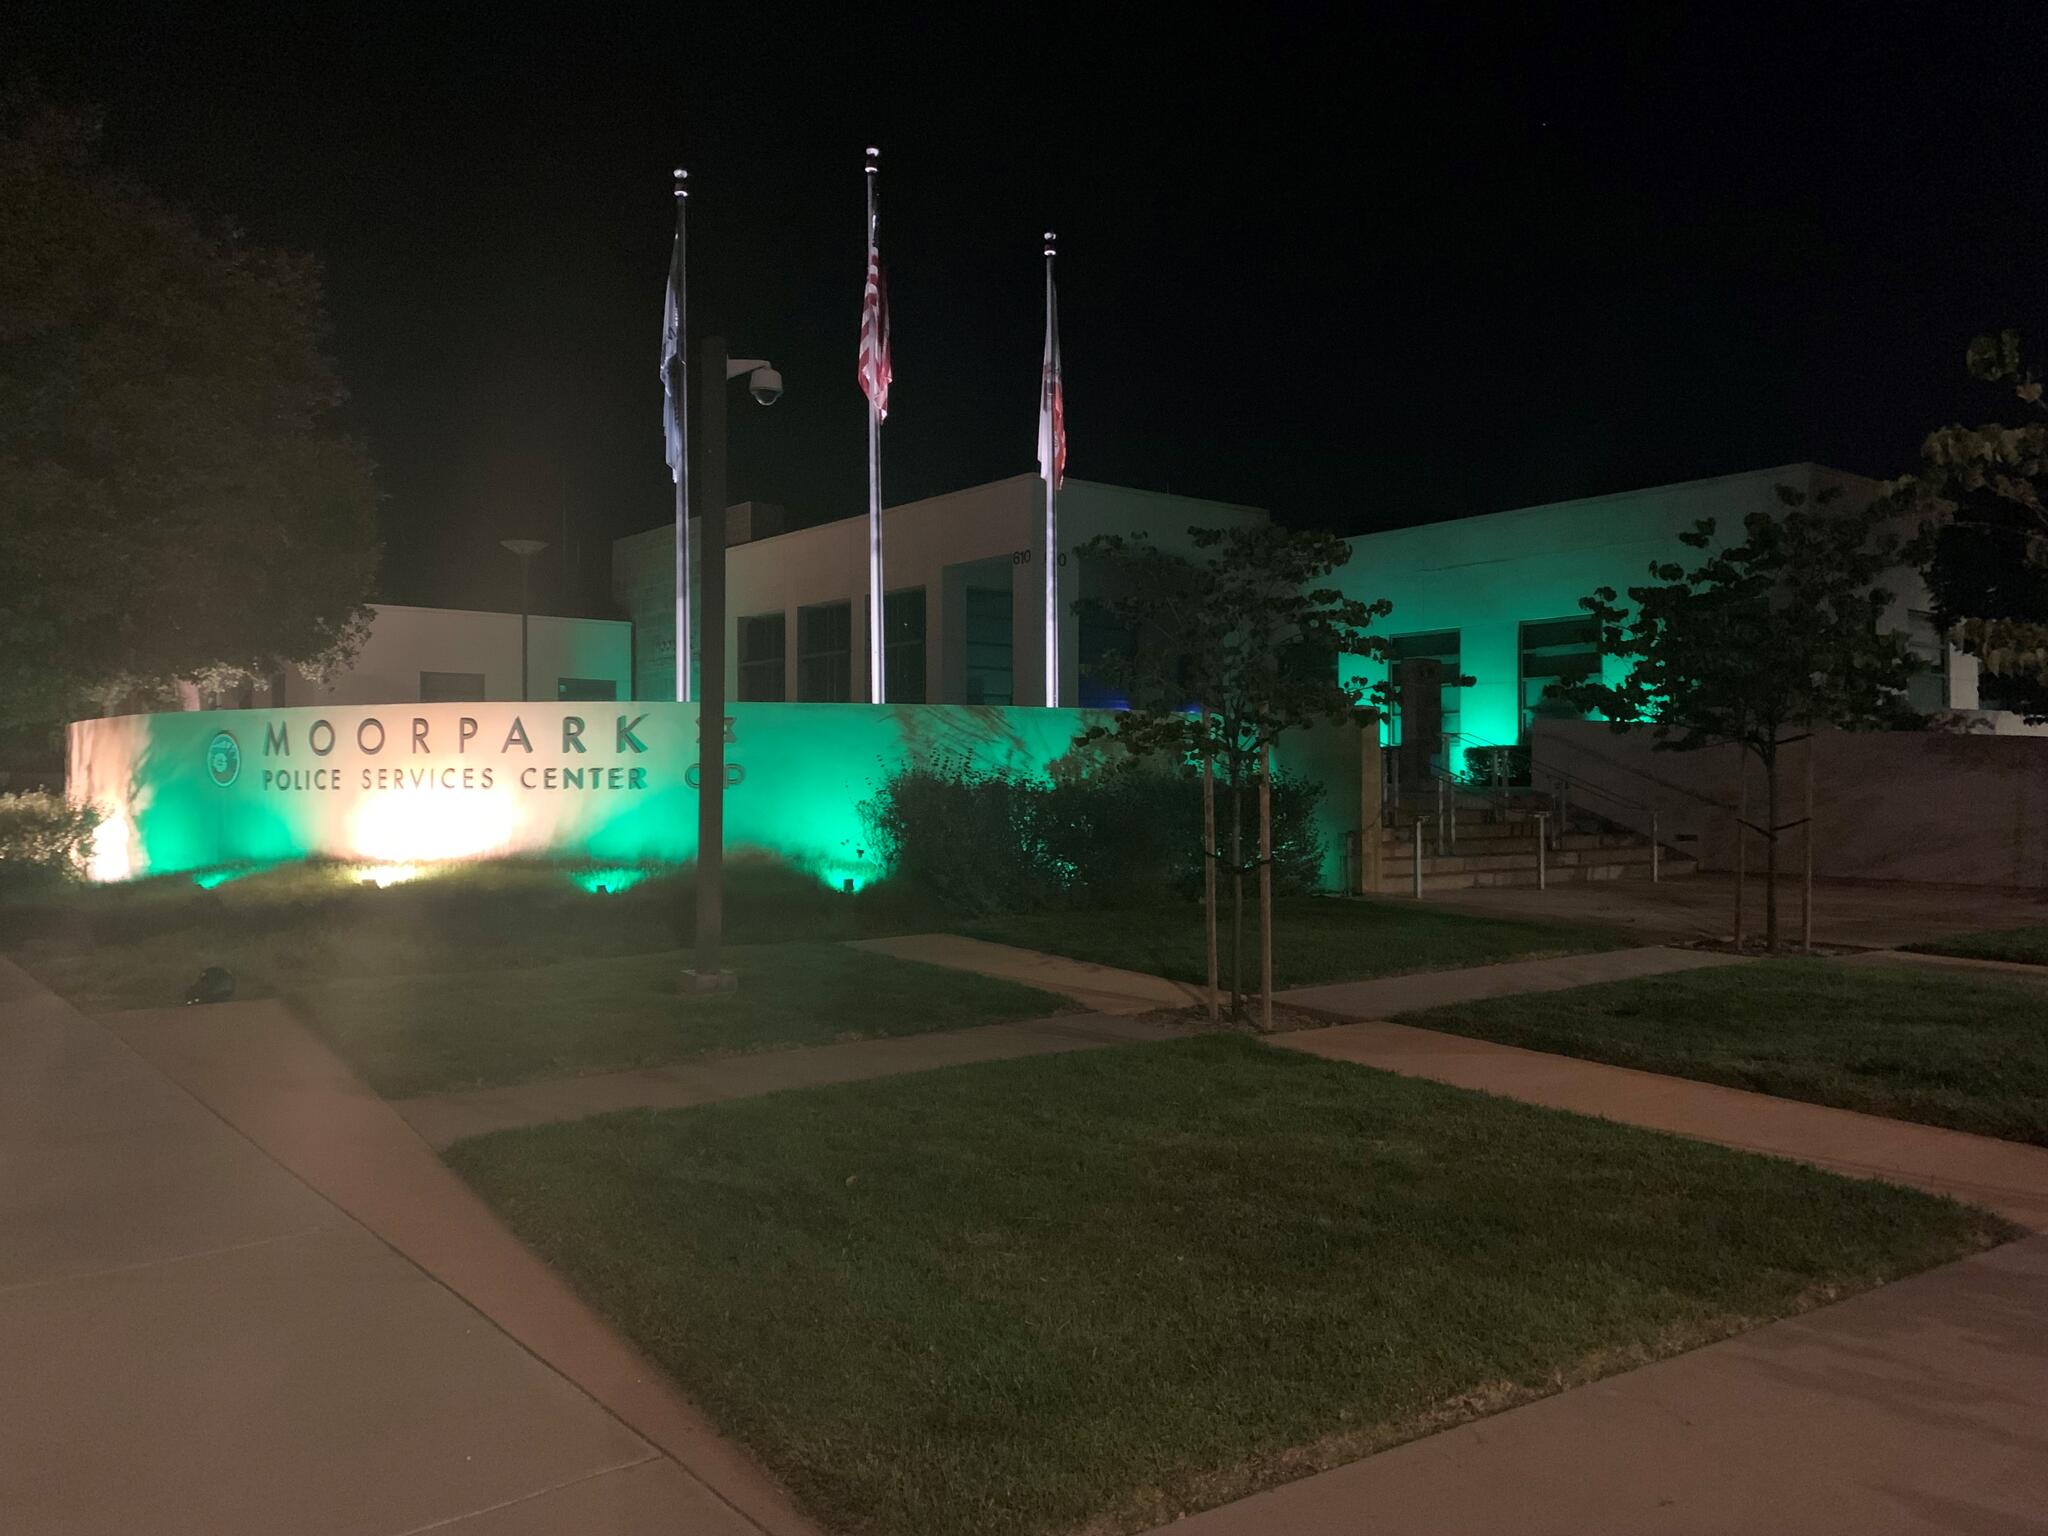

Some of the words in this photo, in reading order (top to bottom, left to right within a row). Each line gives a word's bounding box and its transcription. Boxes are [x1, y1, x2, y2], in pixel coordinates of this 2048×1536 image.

[1012, 549, 1031, 565] 610
[264, 713, 649, 756] MOORPARK
[263, 769, 341, 791] POLICE
[361, 768, 494, 790] SERVICES
[520, 767, 649, 790] CENTER
[684, 763, 746, 789] CP
